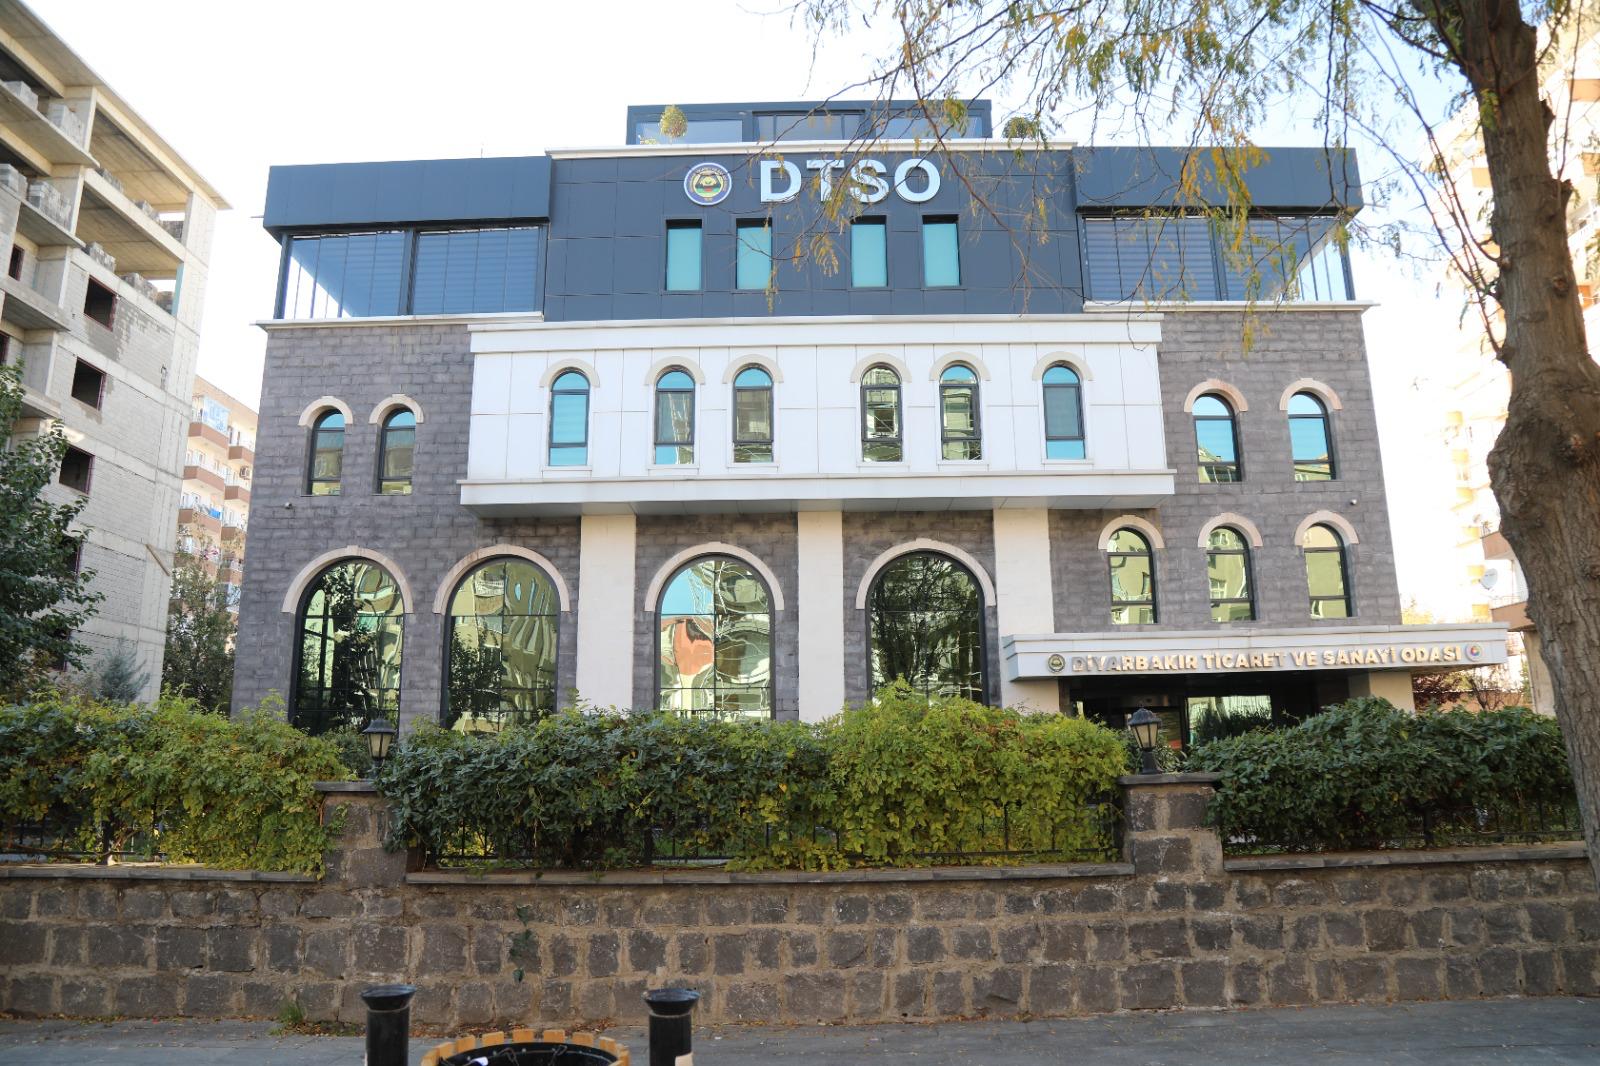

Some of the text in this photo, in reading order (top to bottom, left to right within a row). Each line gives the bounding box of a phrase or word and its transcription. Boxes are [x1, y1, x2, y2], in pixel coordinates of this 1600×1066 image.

[760, 158, 941, 203] DTSO
[1203, 651, 1287, 669] TİCARET
[1291, 650, 1318, 666] VE
[1401, 645, 1461, 663] ODASI
